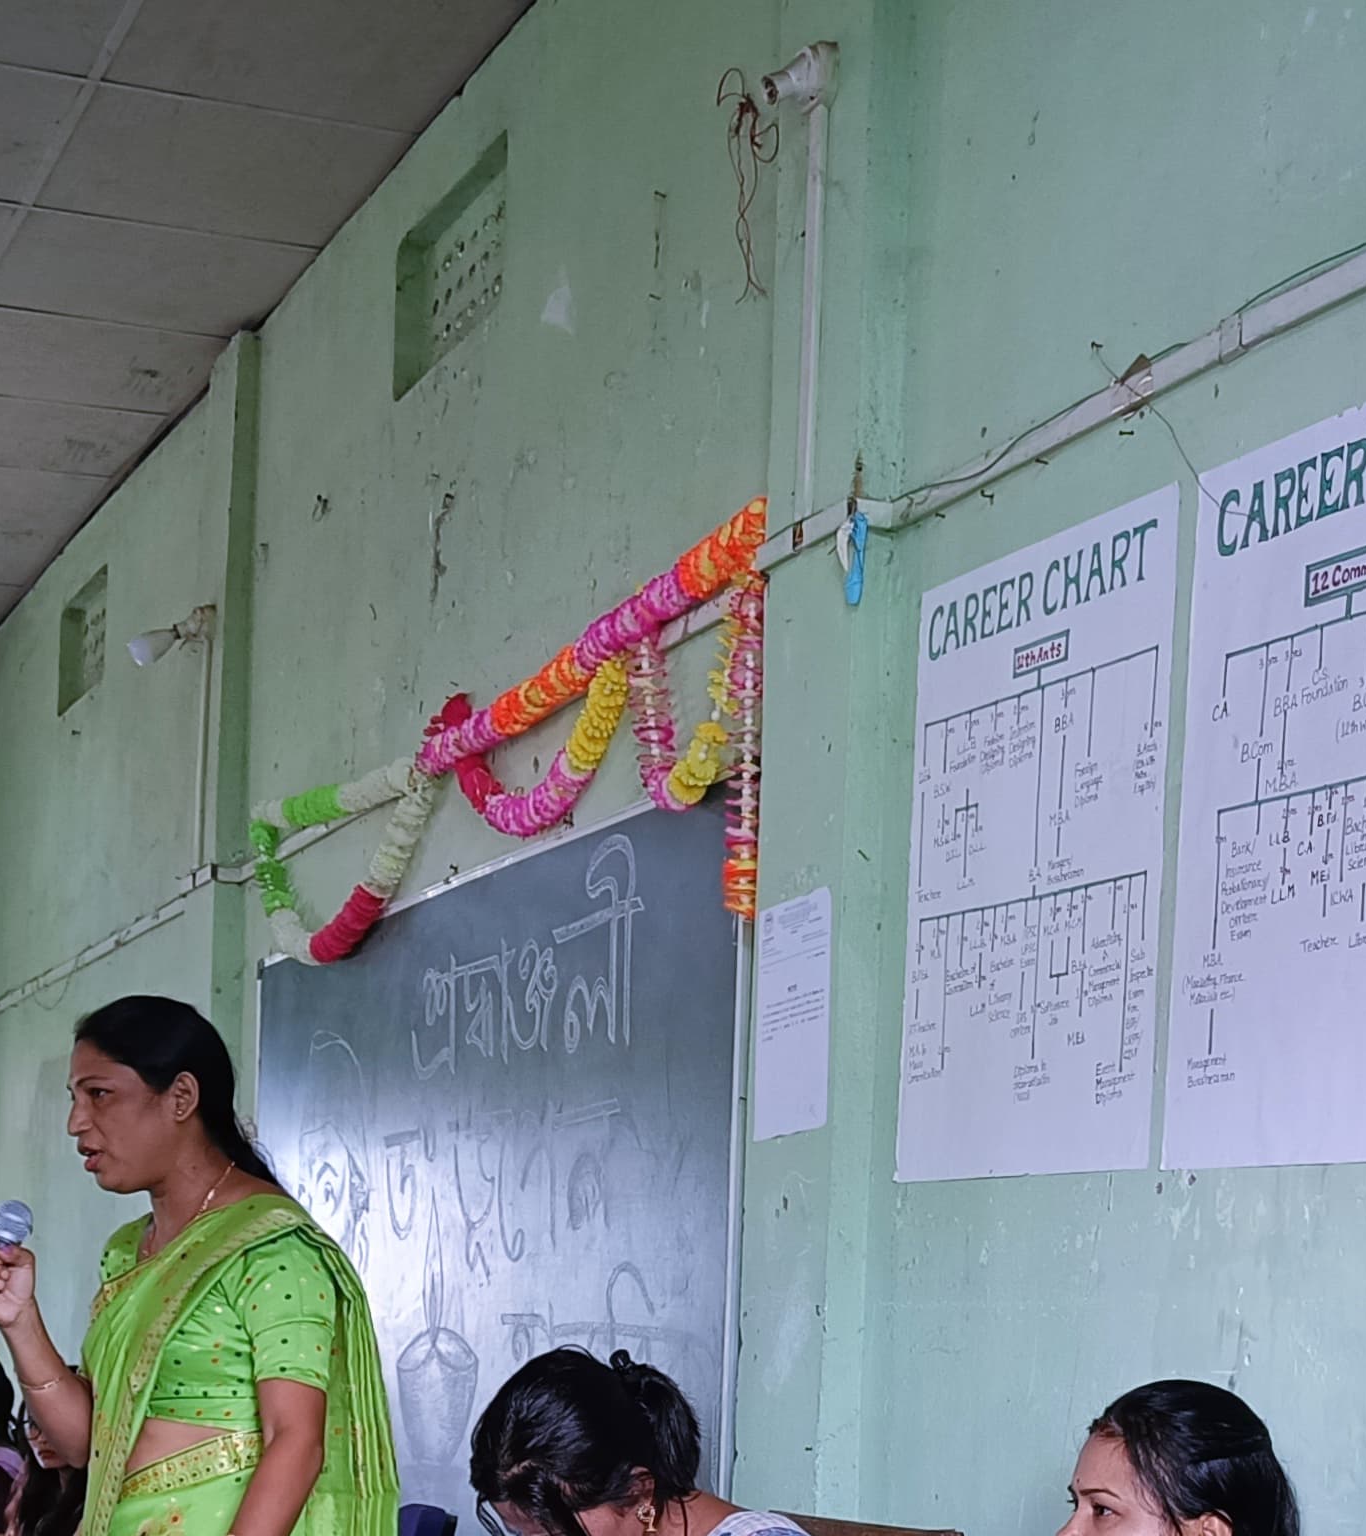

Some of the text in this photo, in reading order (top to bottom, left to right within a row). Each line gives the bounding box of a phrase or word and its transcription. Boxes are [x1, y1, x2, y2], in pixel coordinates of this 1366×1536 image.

[928, 518, 1158, 661] CAREER CHART
[1310, 571, 1330, 596] 12
[1301, 674, 1348, 706] Foundation
